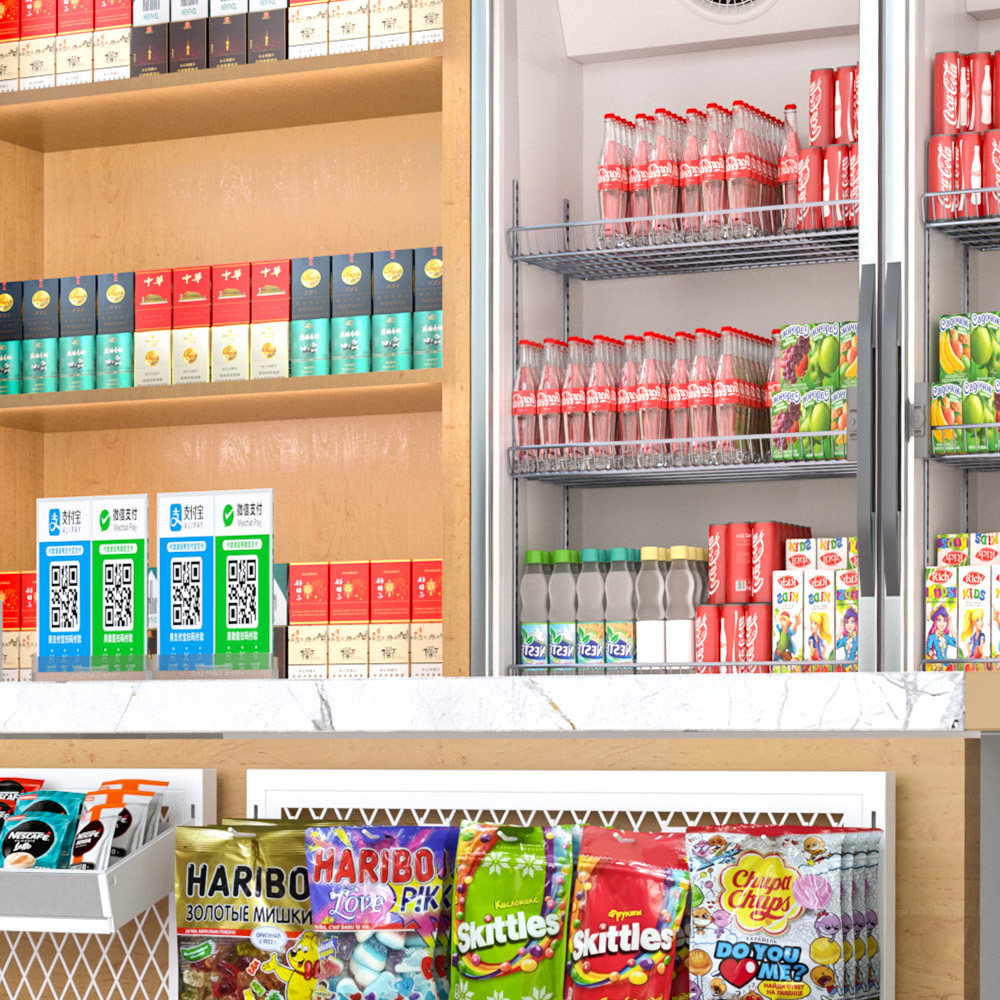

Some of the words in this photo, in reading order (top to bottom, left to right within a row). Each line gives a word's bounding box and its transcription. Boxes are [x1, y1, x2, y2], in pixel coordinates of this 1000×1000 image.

[62, 509, 81, 525] 支付宝
[113, 508, 138, 521] 微信支付
[183, 505, 204, 520] 支付宝
[237, 503, 262, 516] 微信支付
[932, 571, 950, 582] Rich
[965, 573, 983, 583] Rich
[314, 848, 435, 884] HARIBO
[187, 863, 310, 901] HARIBO
[732, 869, 793, 894] Chupa
[329, 886, 385, 920] Love
[727, 889, 792, 914] Chups
[186, 904, 249, 923] ЗОЛОТЫЕ
[253, 905, 314, 925] МИШКИ
[608, 909, 643, 922] Фрукты
[456, 911, 561, 954] Skittles
[572, 922, 674, 961] Skittles
[715, 941, 750, 959] DO
[751, 942, 801, 963] YOU
[757, 961, 809, 981] ME?
